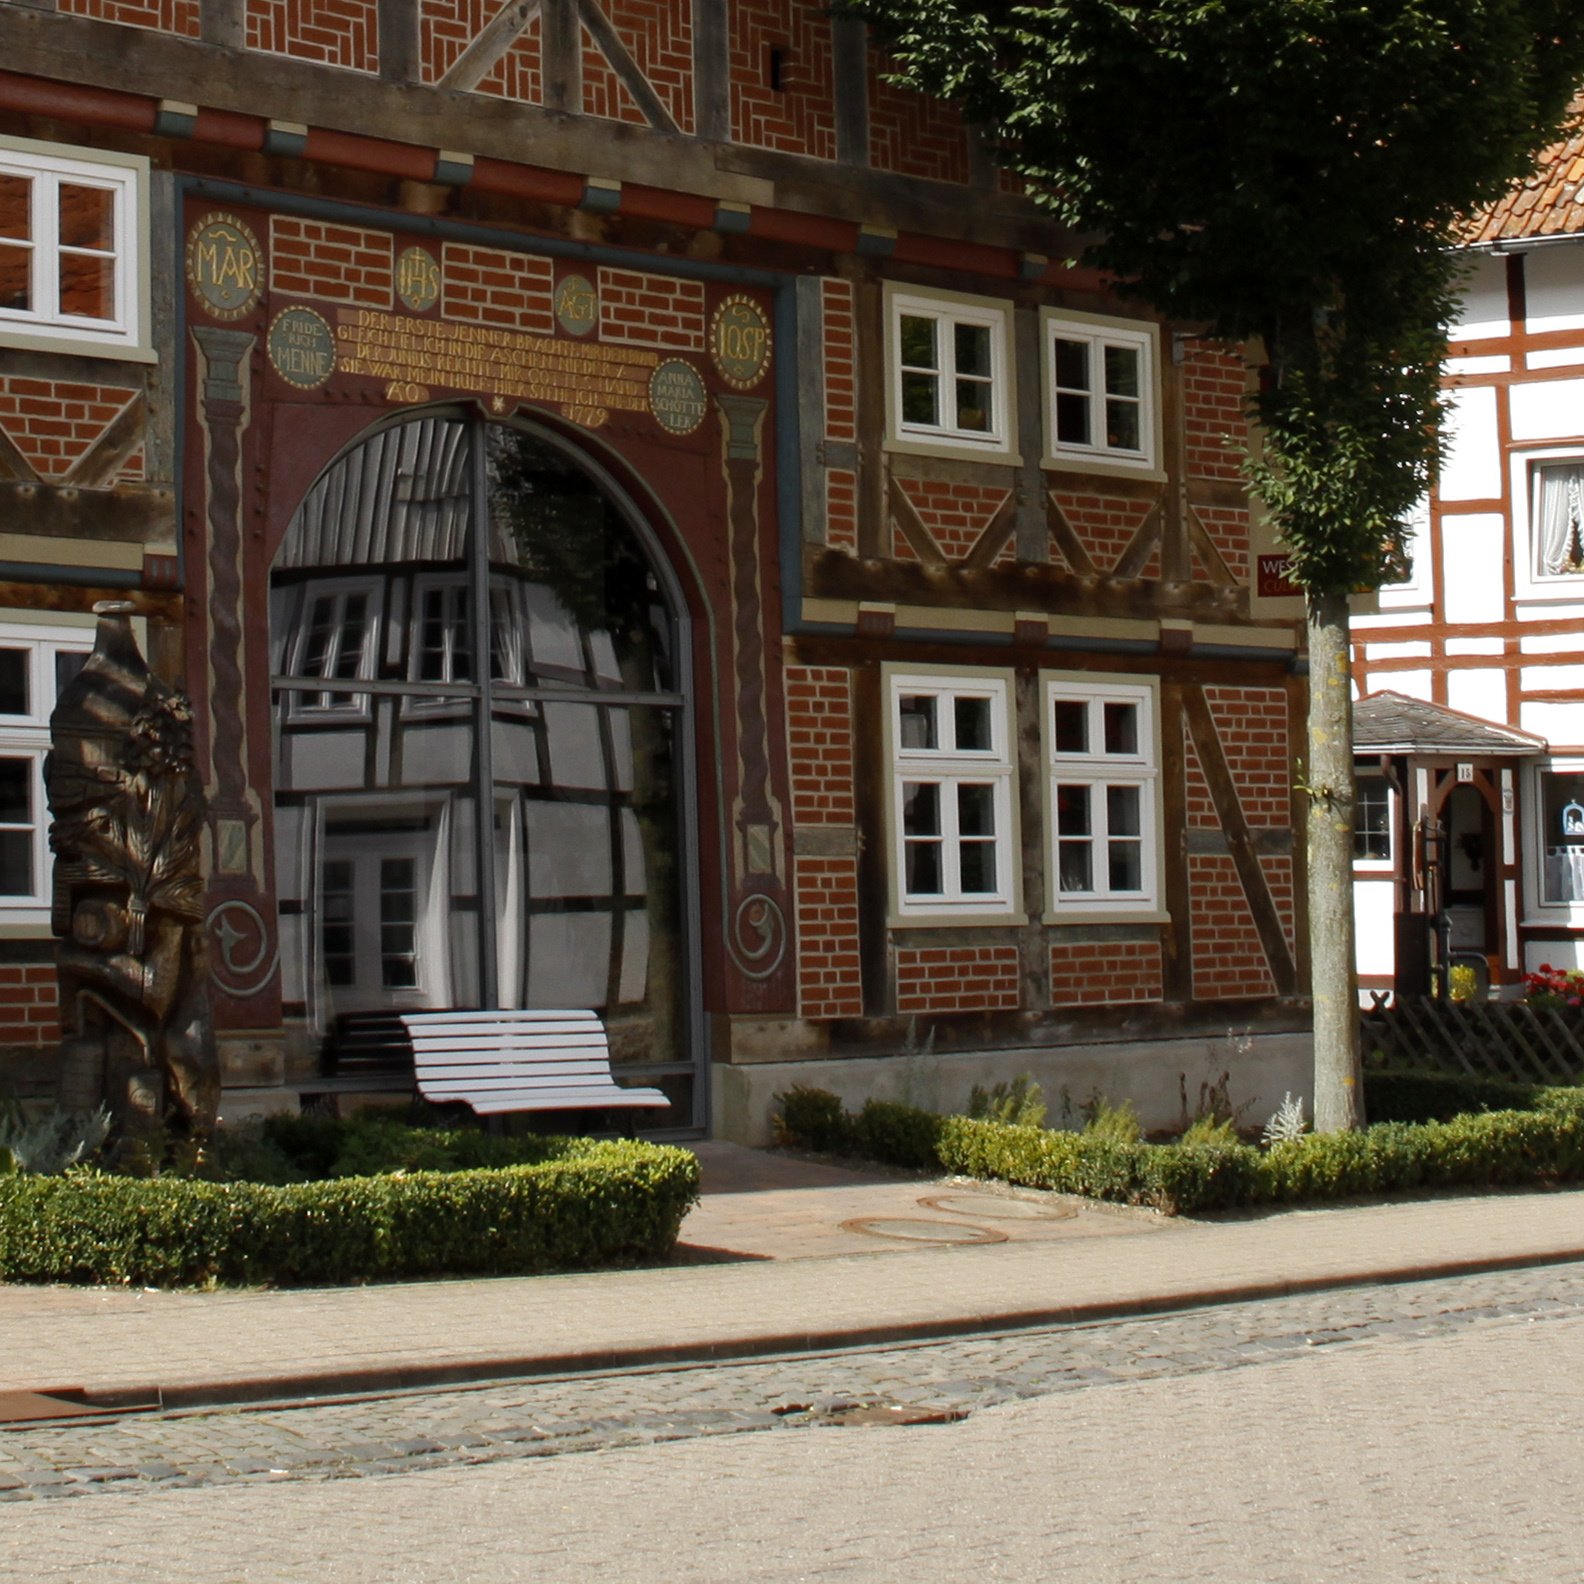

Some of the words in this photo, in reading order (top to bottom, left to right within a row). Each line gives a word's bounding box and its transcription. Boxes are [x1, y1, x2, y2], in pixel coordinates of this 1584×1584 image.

[358, 309, 391, 330] DER
[395, 315, 445, 339] ERSTE
[448, 321, 510, 348] JENNER
[276, 347, 329, 376] MENNE
[340, 357, 364, 374] SIE
[367, 361, 402, 379] WAR
[407, 367, 445, 386] MEIN
